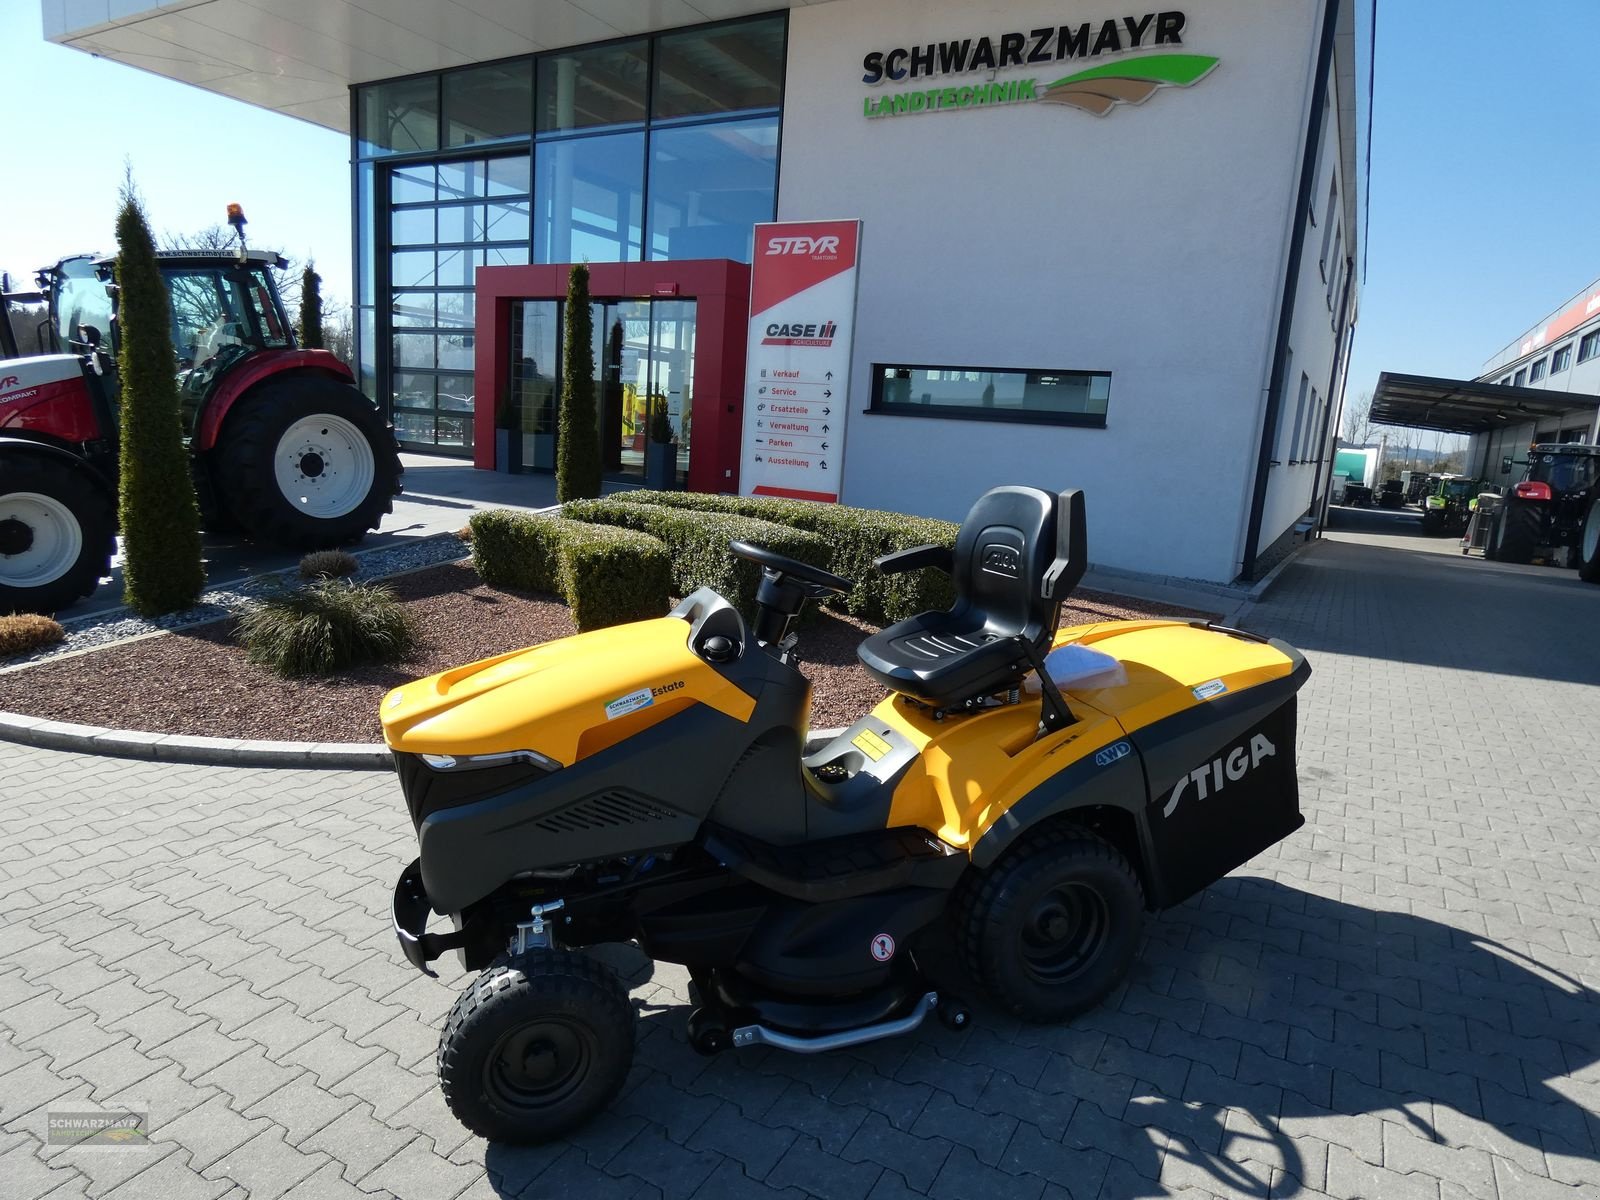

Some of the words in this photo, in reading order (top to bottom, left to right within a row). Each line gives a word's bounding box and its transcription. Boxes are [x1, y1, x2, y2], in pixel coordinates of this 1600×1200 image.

[862, 11, 1186, 83] SCHWARZMAYR
[863, 78, 1037, 118] LANDTECHNIK
[765, 236, 840, 255] STEYR
[157, 250, 235, 258] ww.schwarzmayr.at
[766, 323, 817, 338] CASE
[772, 369, 800, 379] Verkauf
[771, 387, 797, 396] Service
[770, 404, 809, 415] Ersatzteile
[769, 421, 809, 432] Verwaltung
[768, 438, 793, 447] Parken
[767, 456, 809, 468] Ausstellung
[651, 680, 685, 697] Estate
[1096, 741, 1131, 766] 4WD
[1163, 733, 1276, 818] STIGA
